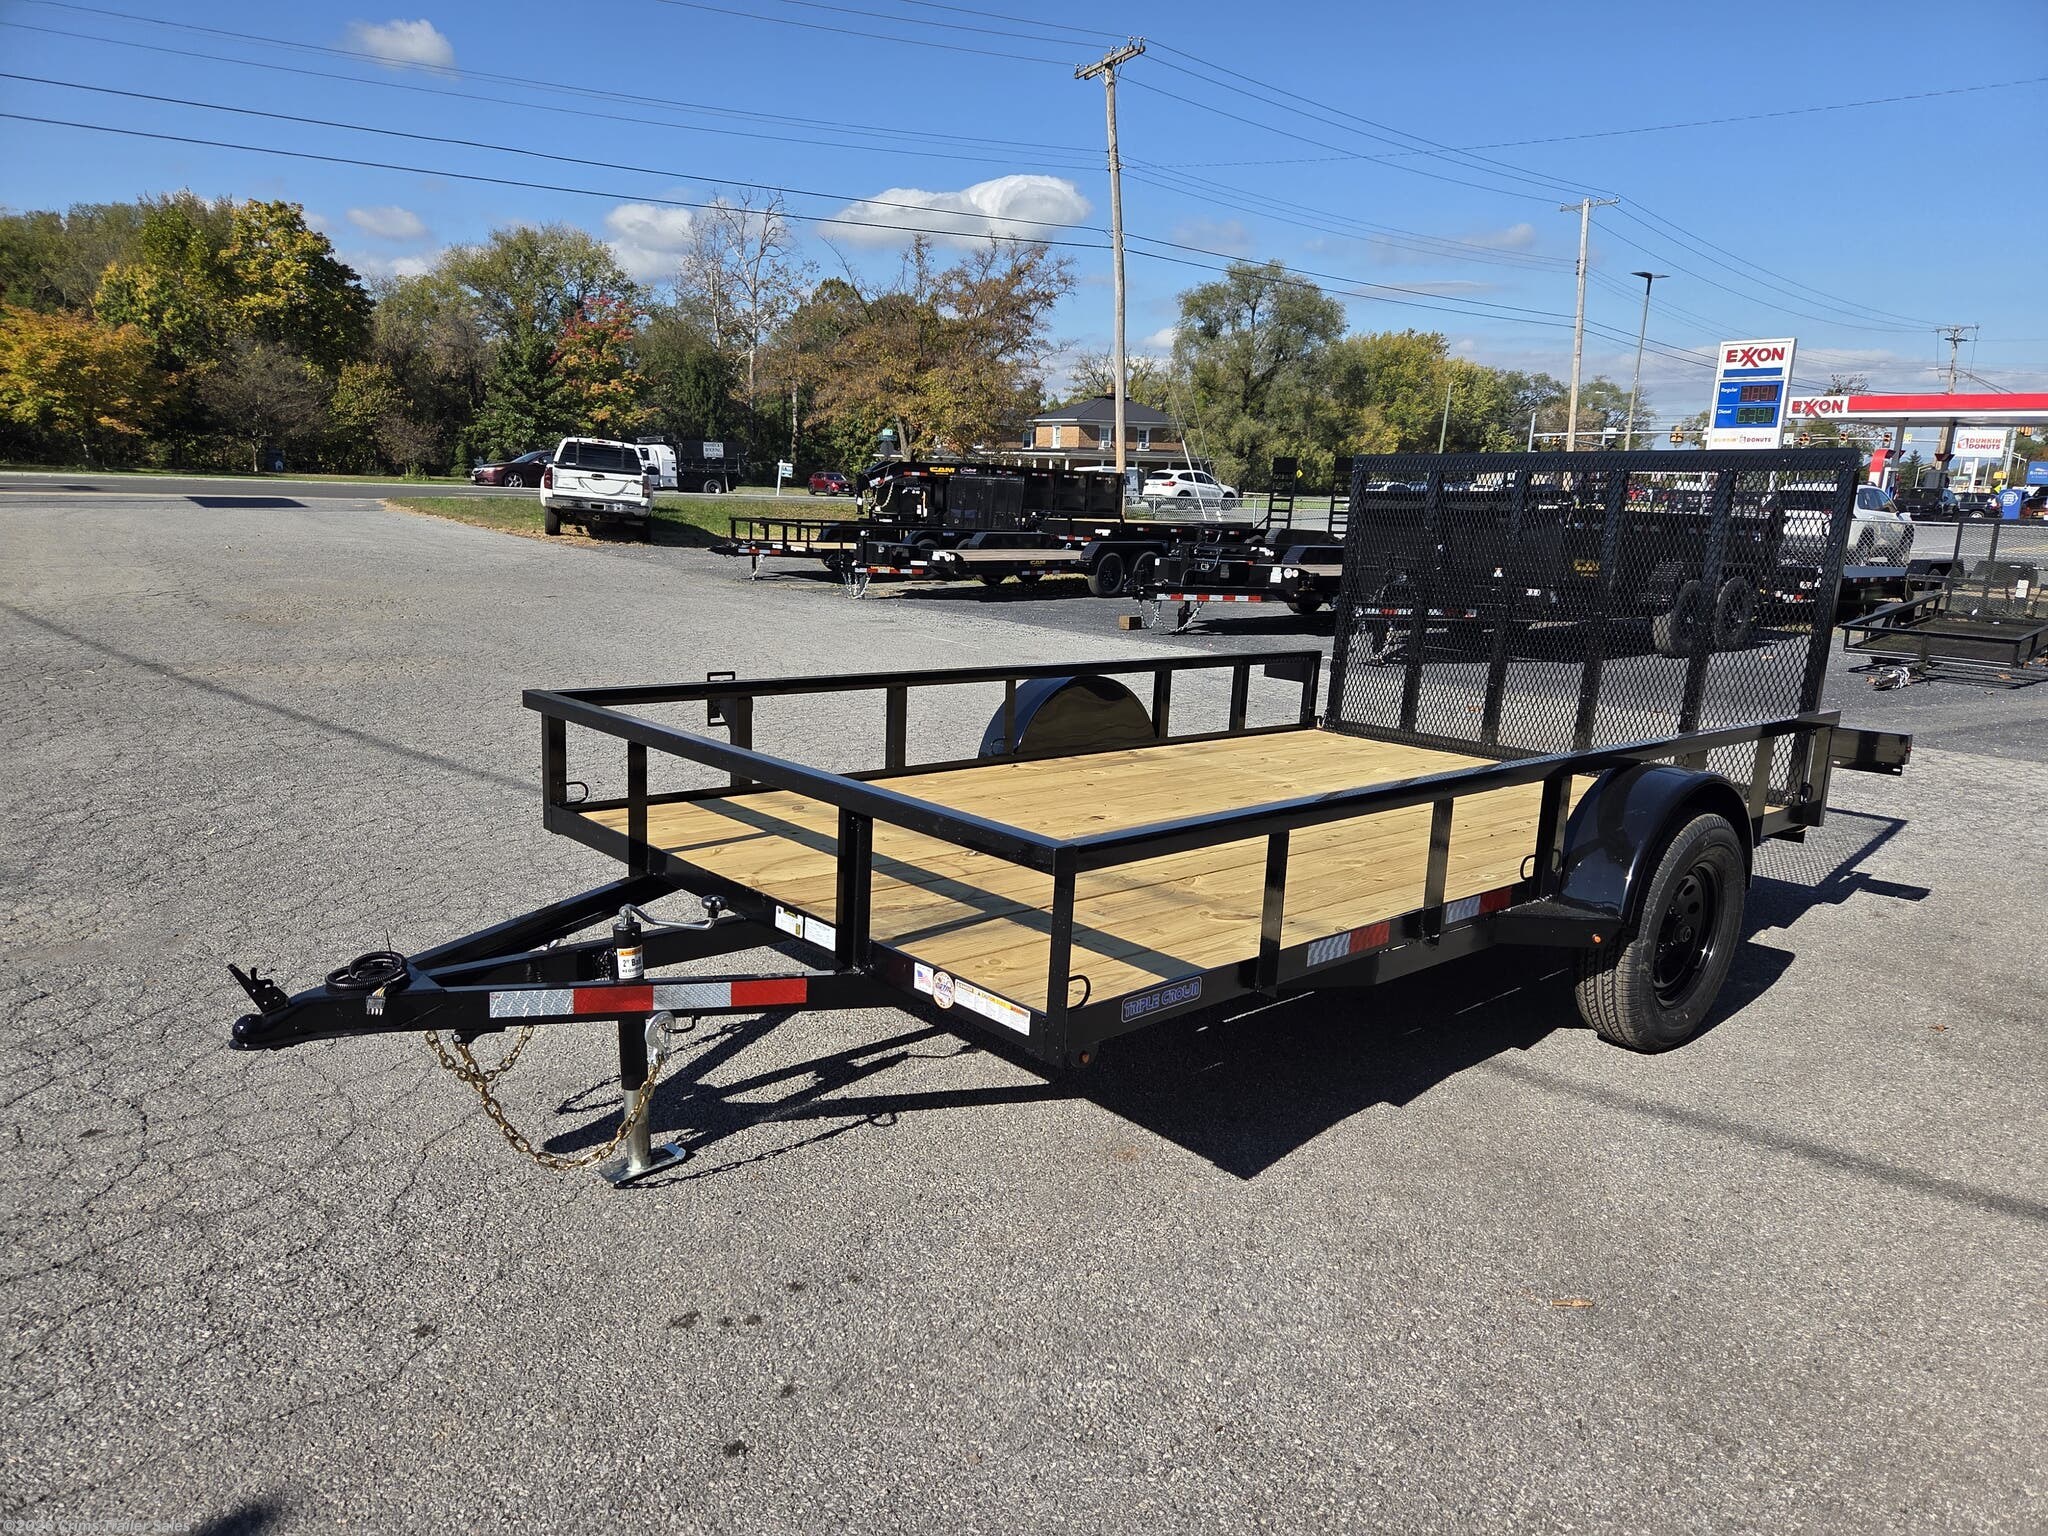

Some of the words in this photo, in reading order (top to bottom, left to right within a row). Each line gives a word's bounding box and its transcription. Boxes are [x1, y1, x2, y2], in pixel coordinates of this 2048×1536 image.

[1726, 347, 1785, 367] EXXON
[1792, 398, 1843, 418] EXXON
[1124, 993, 1160, 1017] TRIPLE
